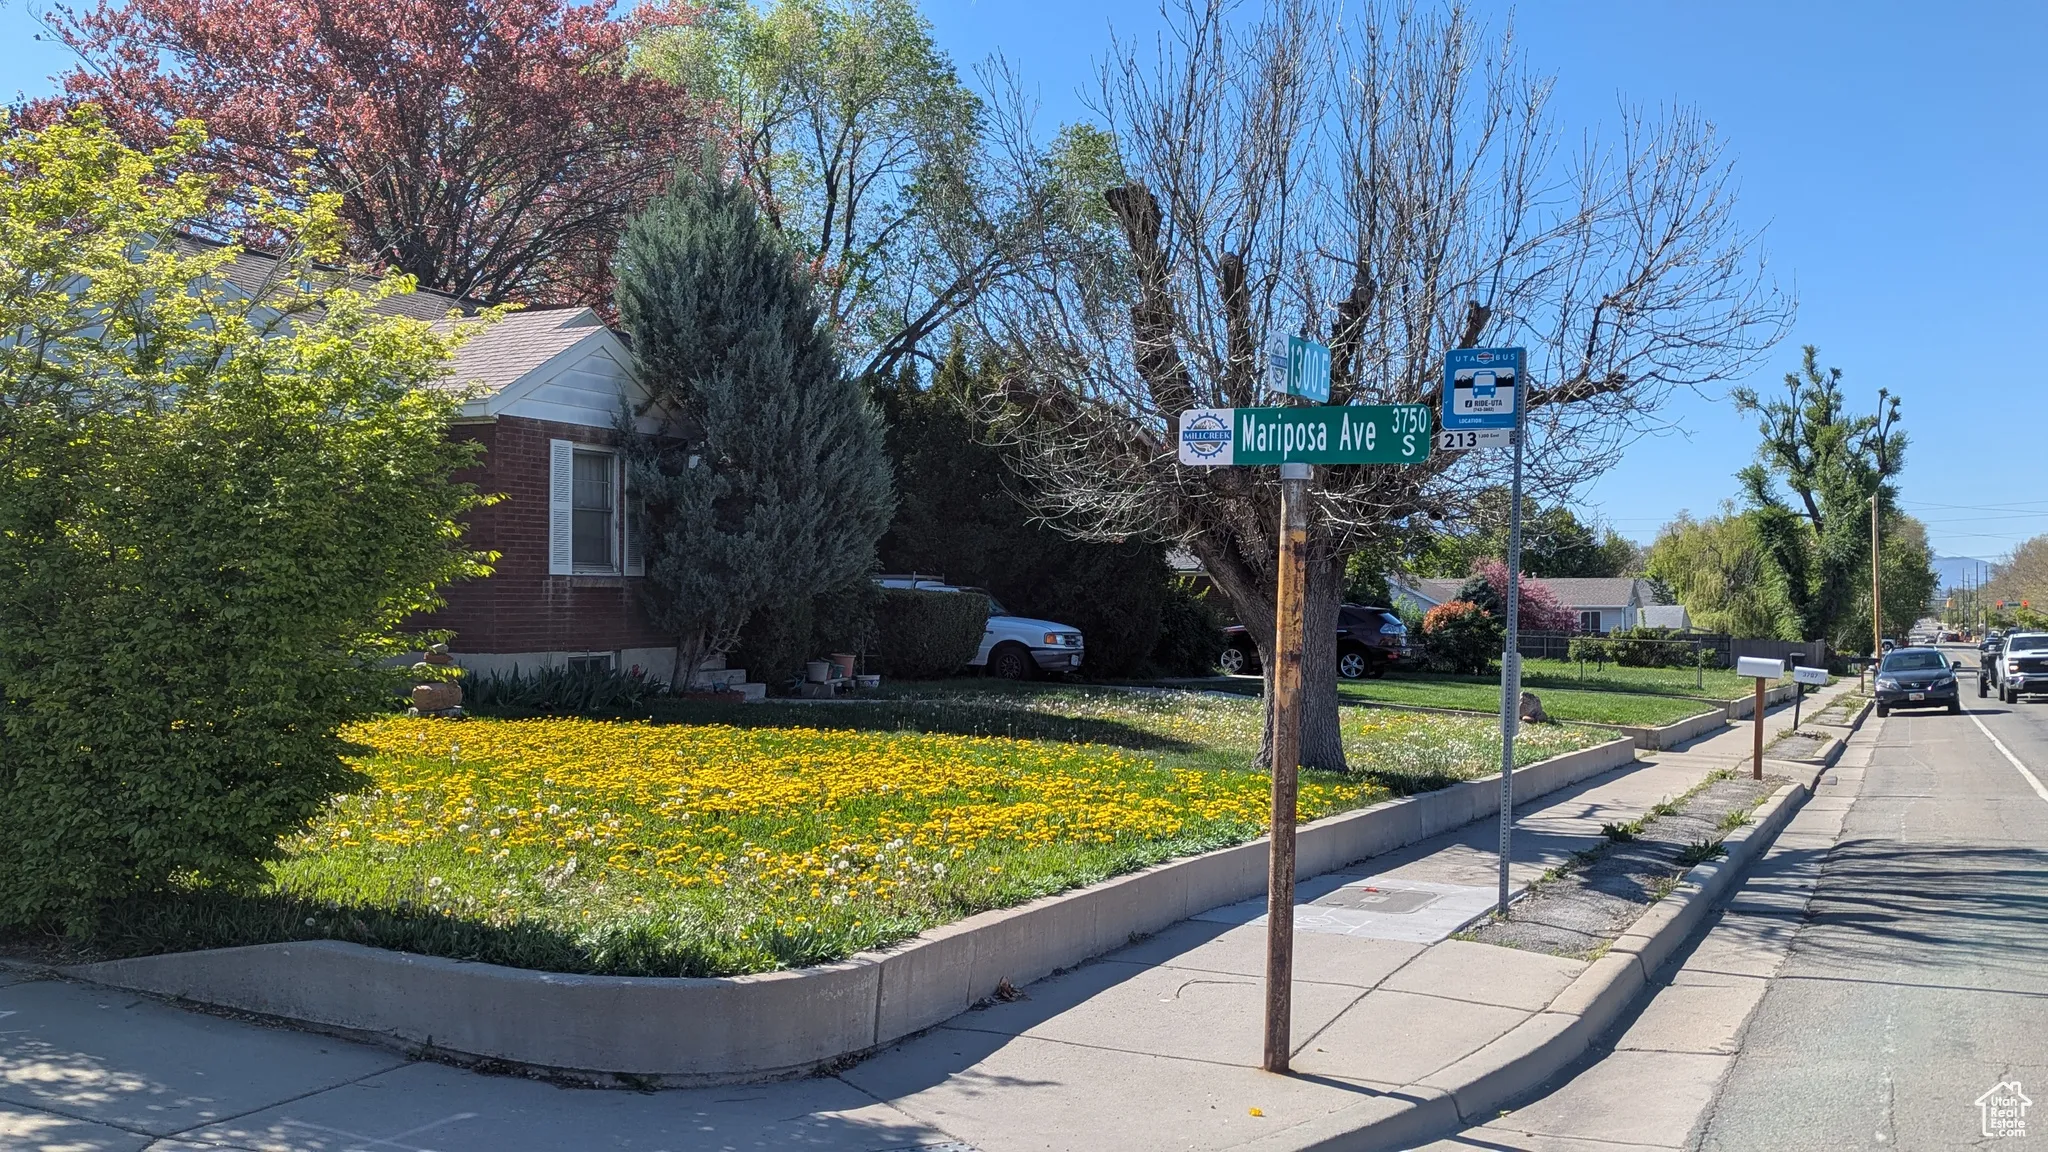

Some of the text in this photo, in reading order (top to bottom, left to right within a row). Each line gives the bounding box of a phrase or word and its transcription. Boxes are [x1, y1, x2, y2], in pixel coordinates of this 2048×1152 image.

[1495, 353, 1515, 361] BUS
[1474, 399, 1503, 407] RIDE-UTA
[1392, 407, 1427, 434] 3750
[1183, 431, 1231, 440] MILLCREEK
[1242, 412, 1376, 461] Mariposa Ave
[1444, 431, 1477, 448] 213
[1401, 434, 1416, 456] S
